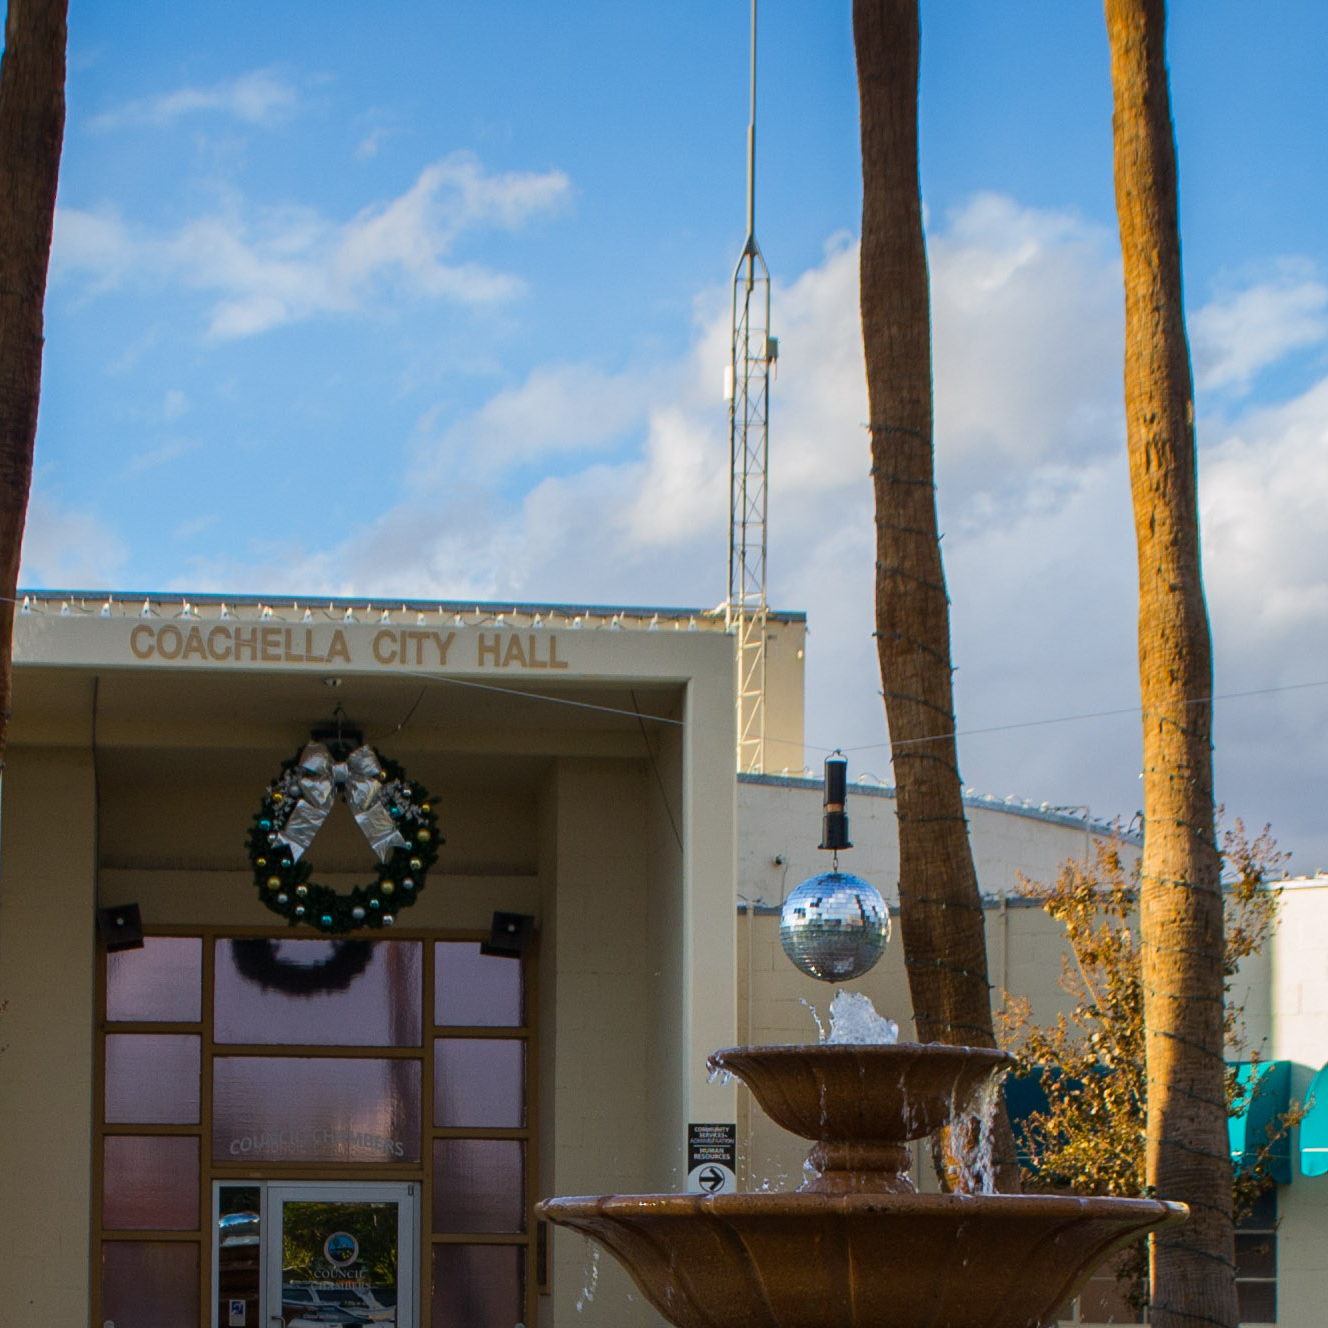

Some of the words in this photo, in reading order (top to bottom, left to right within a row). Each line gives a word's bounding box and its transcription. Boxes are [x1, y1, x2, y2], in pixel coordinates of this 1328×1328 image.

[129, 624, 351, 664] COACHELLA
[372, 629, 455, 666] CITY
[477, 632, 569, 669] HALL
[229, 1129, 300, 1155] COUNCIL
[312, 1128, 405, 1157] CHAMBERS
[313, 1269, 366, 1279] COUNCIL
